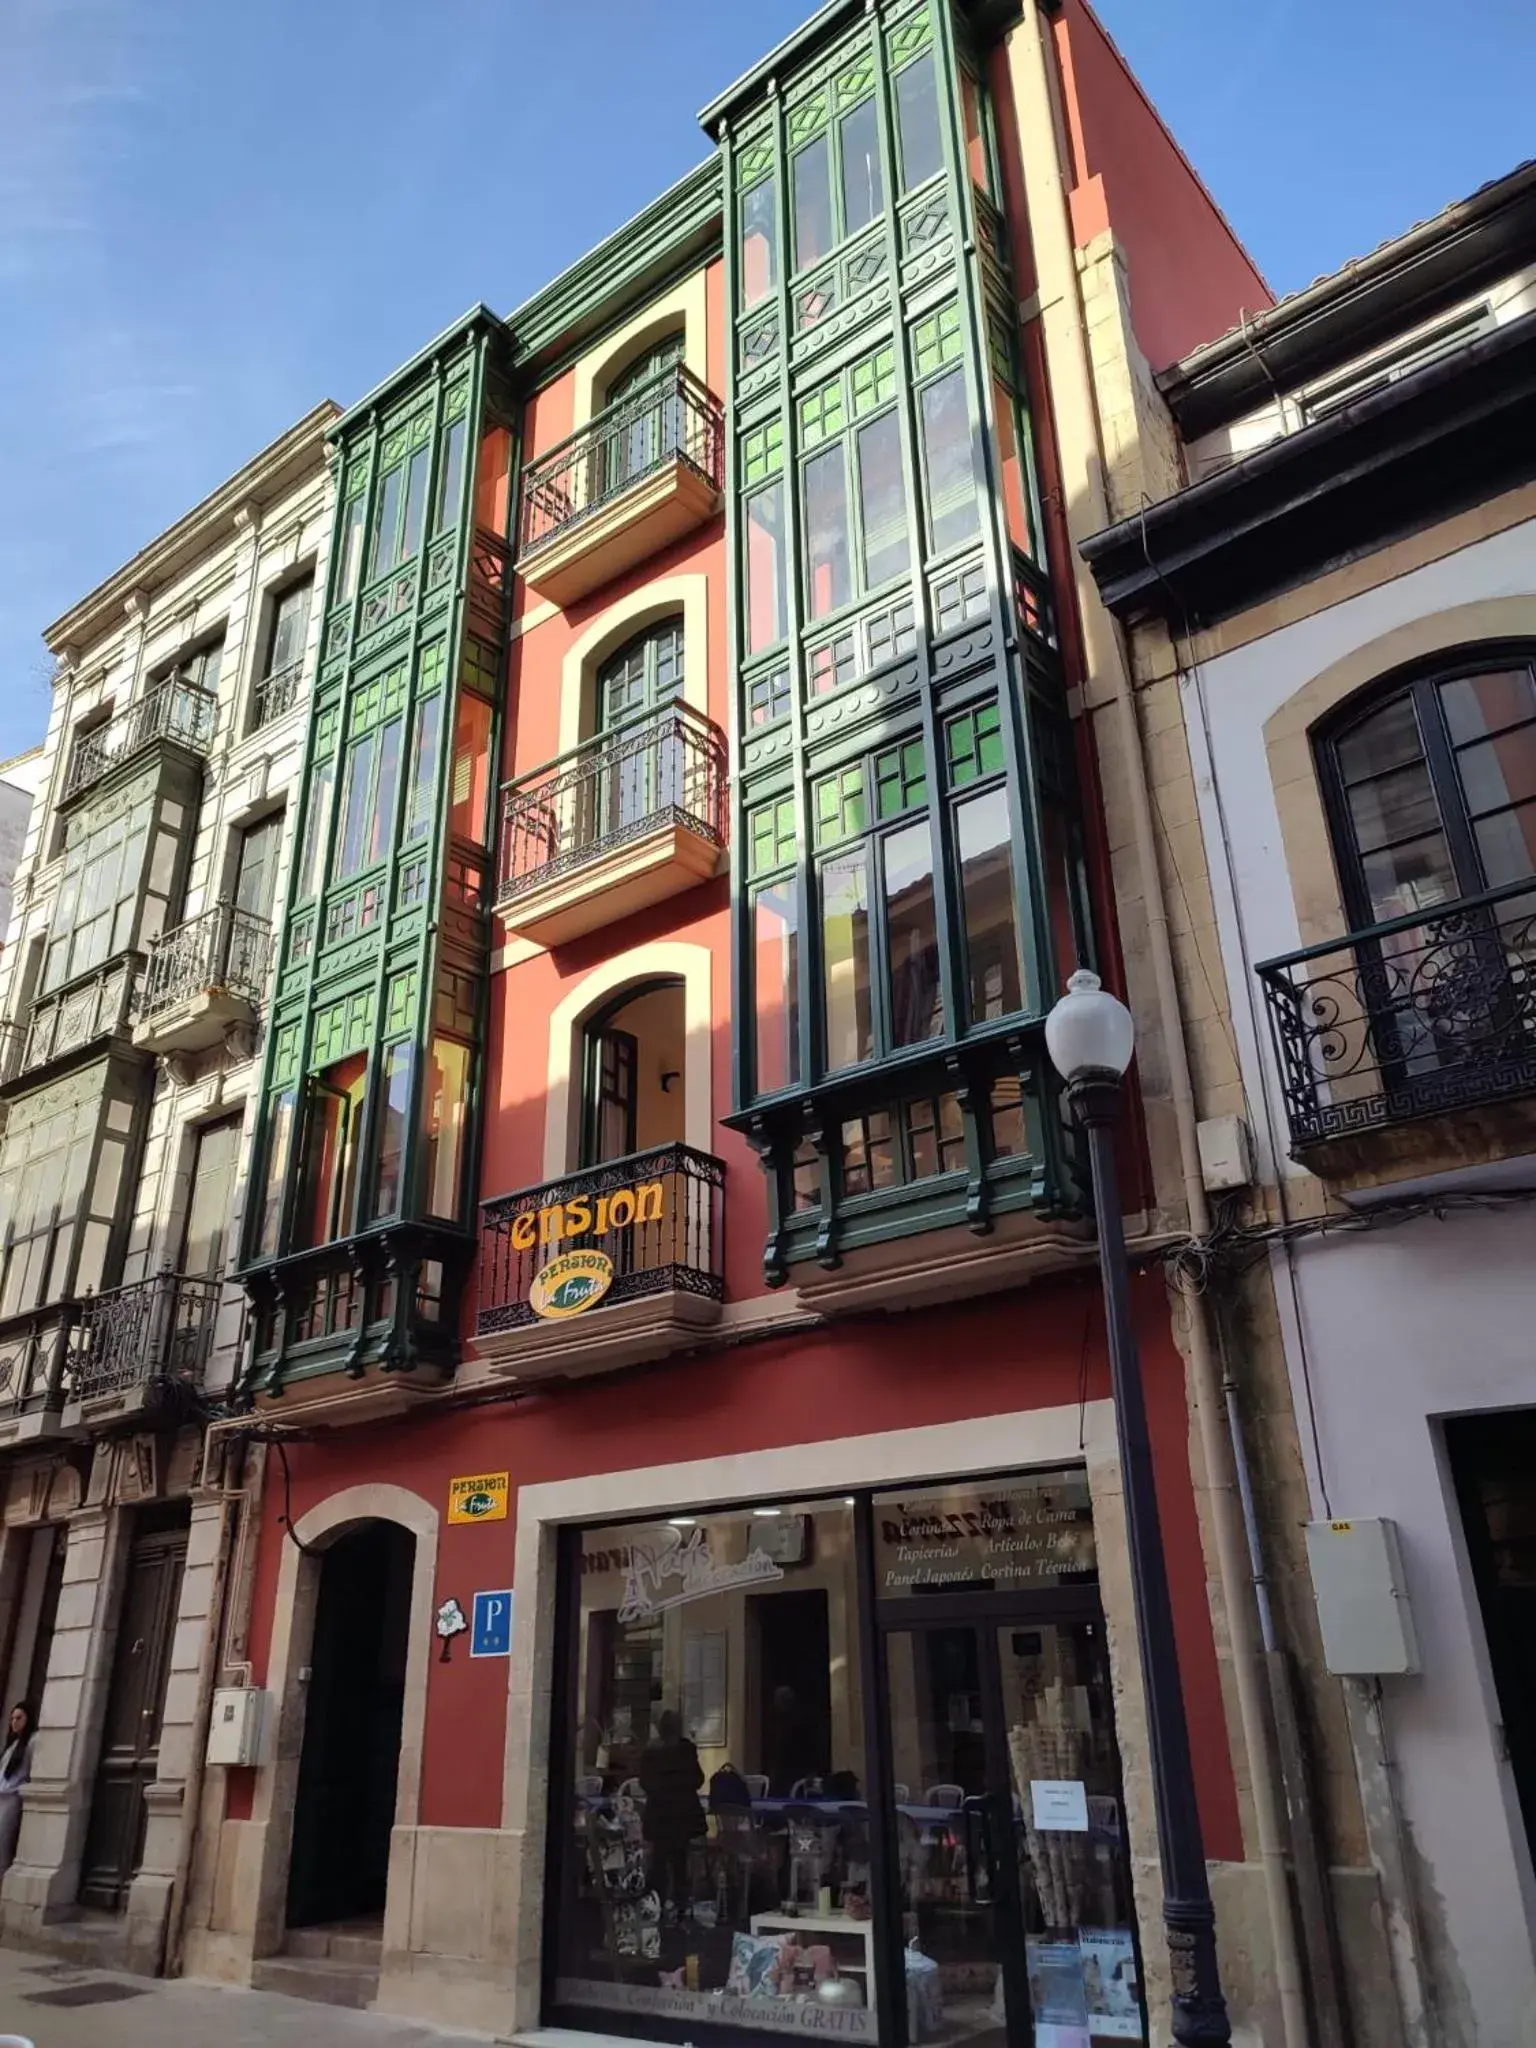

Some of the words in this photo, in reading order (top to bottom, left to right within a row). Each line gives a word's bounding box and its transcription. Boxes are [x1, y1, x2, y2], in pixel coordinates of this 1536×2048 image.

[511, 1182, 663, 1250] ension
[981, 1562, 1031, 1580] Cortina
[486, 1600, 503, 1632] P
[801, 2006, 867, 2033] GRATIS
